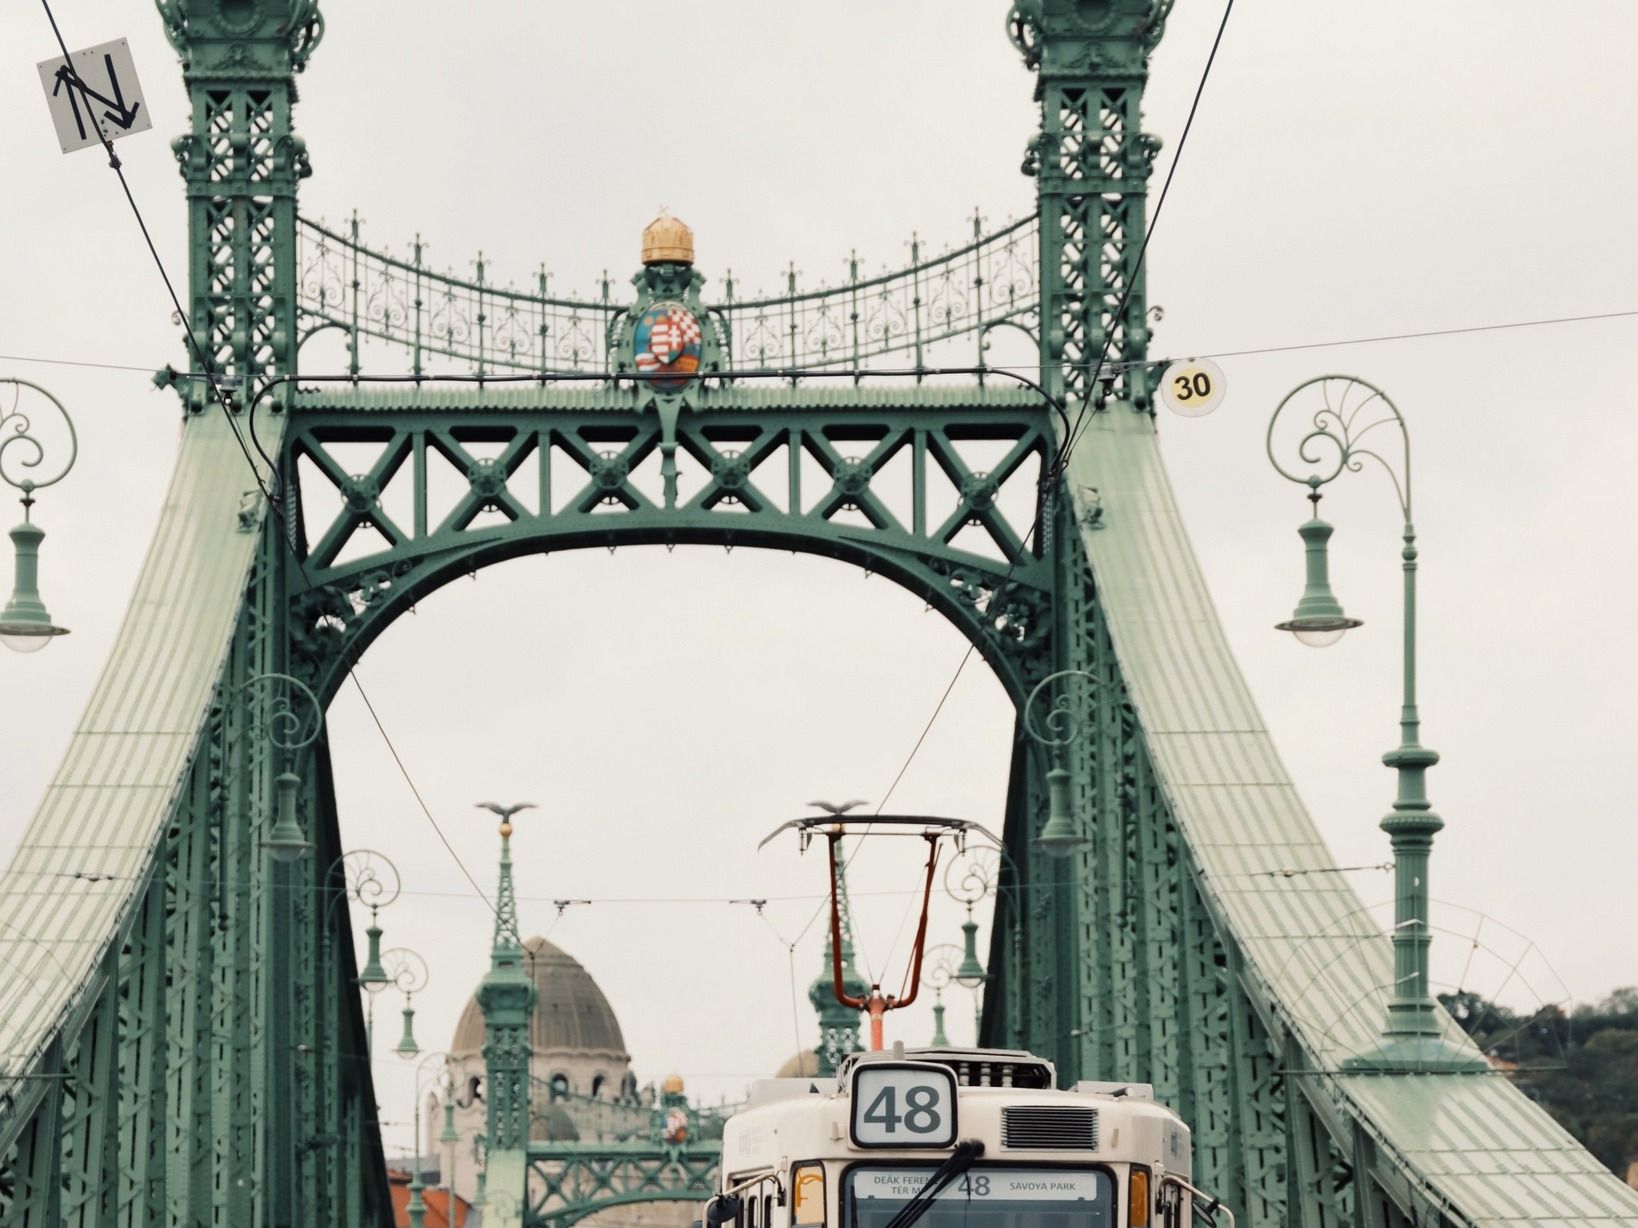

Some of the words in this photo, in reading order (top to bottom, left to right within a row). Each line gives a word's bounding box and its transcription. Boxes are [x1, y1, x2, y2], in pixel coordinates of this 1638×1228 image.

[1174, 372, 1211, 401] 30
[863, 1085, 941, 1134] 48
[873, 1174, 900, 1185] DEÁK
[958, 1175, 991, 1196] 48
[1010, 1182, 1047, 1191] SAVOYA
[1050, 1182, 1076, 1191] PARK
[891, 1185, 909, 1195] TÉR
